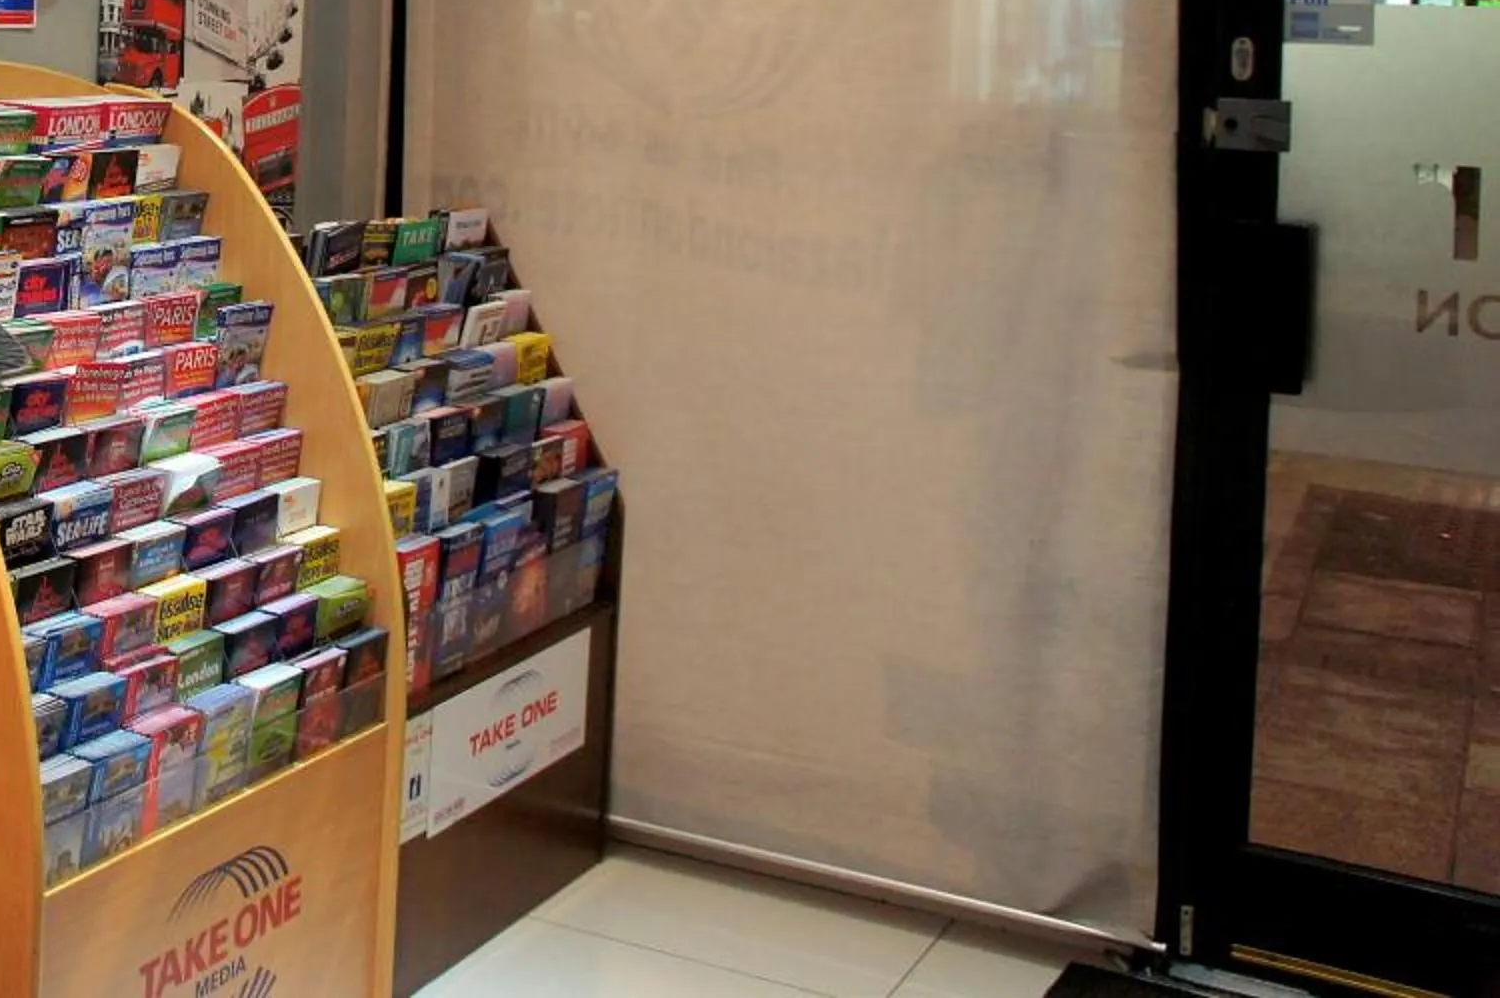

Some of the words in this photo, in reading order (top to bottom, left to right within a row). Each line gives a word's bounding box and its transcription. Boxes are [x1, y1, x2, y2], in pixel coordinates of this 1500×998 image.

[110, 109, 166, 130] LONDON
[152, 304, 196, 327] PARIS
[175, 348, 218, 372] PARIS
[11, 509, 47, 530] STAR
[5, 521, 43, 547] WARS
[177, 661, 220, 689] London
[468, 713, 516, 757] TAKE
[521, 690, 560, 729] ONE
[138, 917, 231, 998] TAKE
[233, 872, 303, 950] ONE
[194, 953, 248, 998] MEDIA
